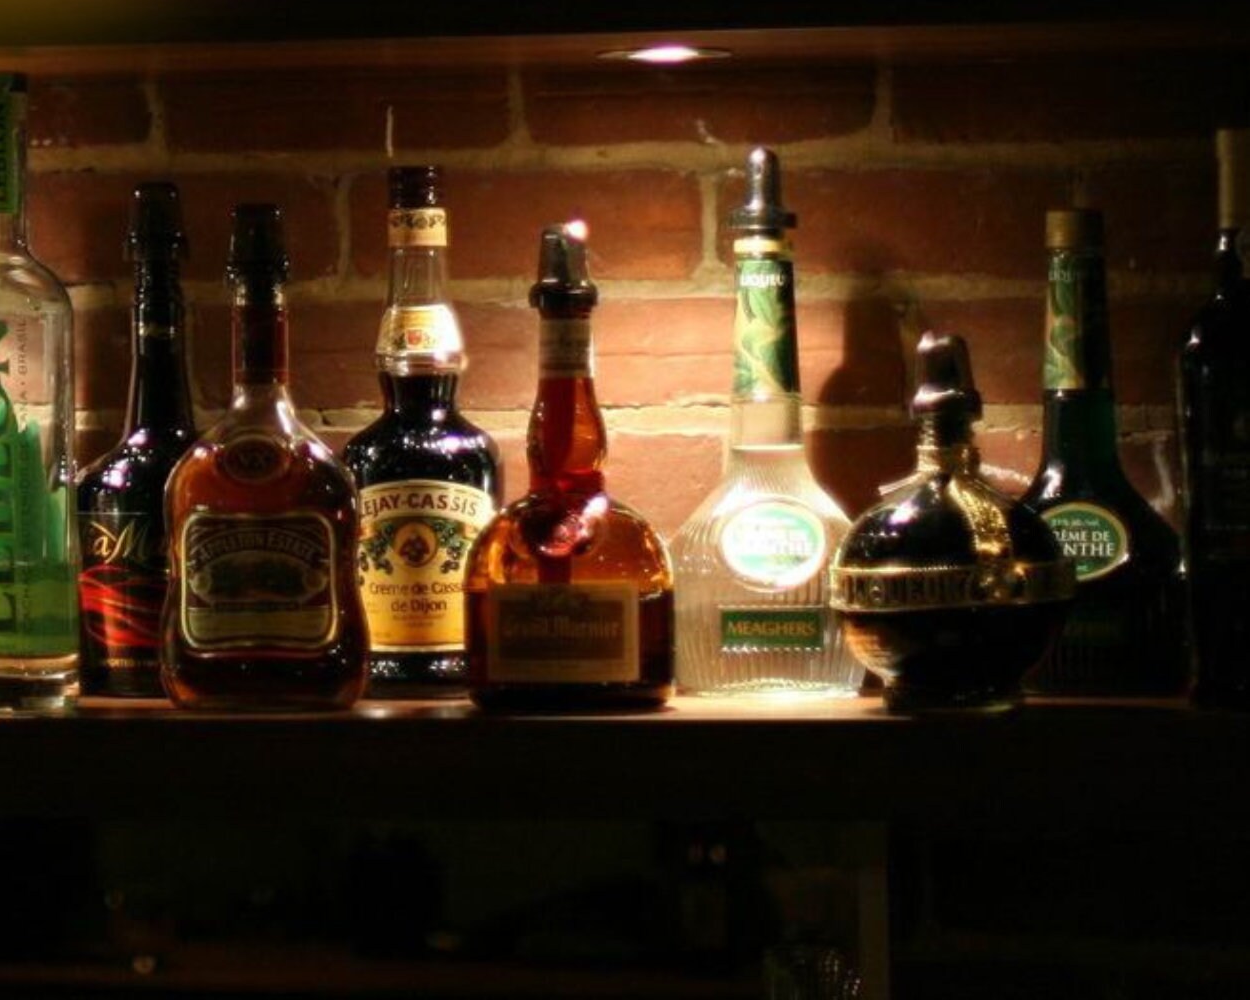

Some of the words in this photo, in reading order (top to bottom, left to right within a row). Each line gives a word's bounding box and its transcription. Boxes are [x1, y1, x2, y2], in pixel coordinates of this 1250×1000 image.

[740, 273, 785, 288] LIQUEU
[1092, 531, 1111, 542] DE
[1062, 543, 1116, 557] NTHE
[431, 582, 462, 594] Cass
[391, 600, 407, 612] de
[410, 599, 448, 614] Dijon
[728, 621, 816, 637] MEAGHERS
